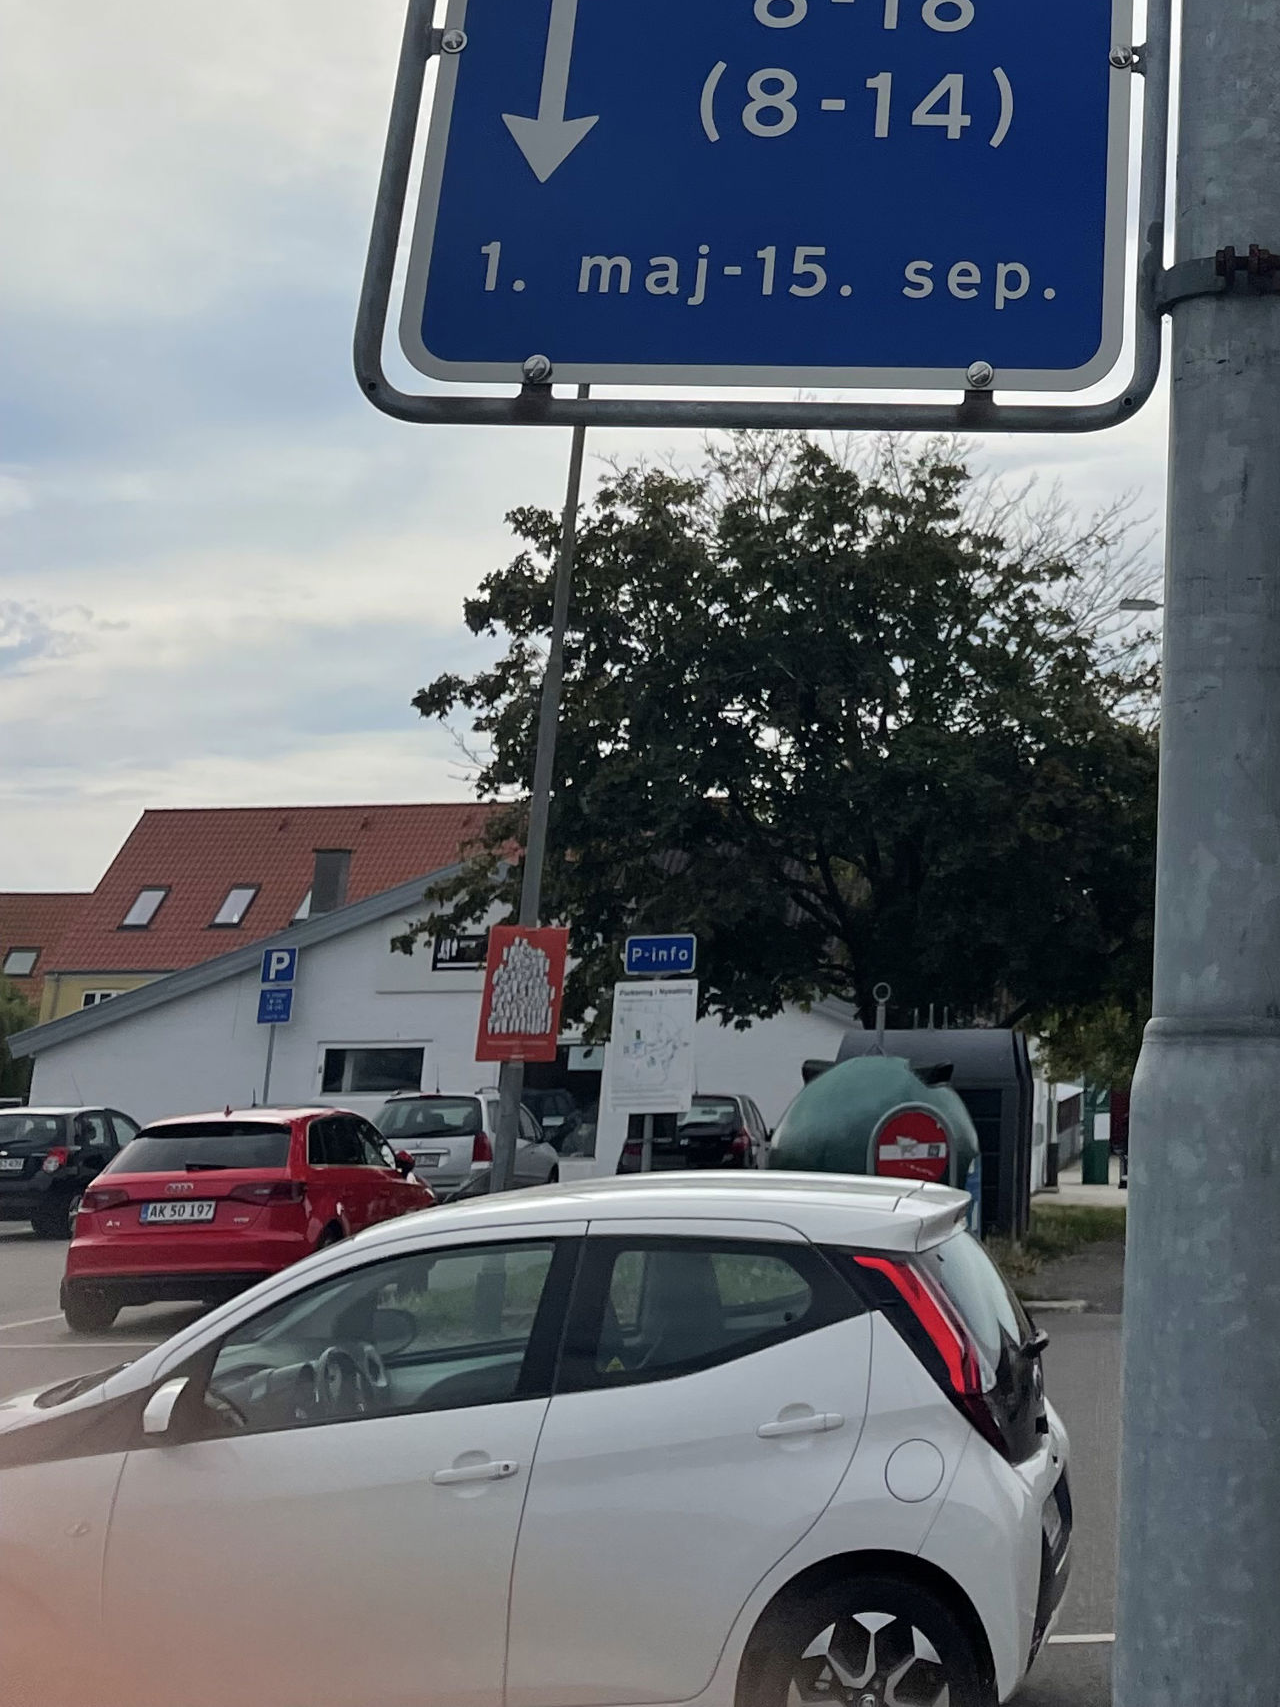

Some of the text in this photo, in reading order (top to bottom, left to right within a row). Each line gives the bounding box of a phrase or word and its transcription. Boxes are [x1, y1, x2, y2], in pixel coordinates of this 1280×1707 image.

[699, 59, 1015, 149] (8-14)
[480, 240, 1057, 311] 1. maj-15. sep.
[269, 951, 290, 981] P
[631, 945, 689, 963] P-info
[150, 1203, 213, 1218] AK 50 197
